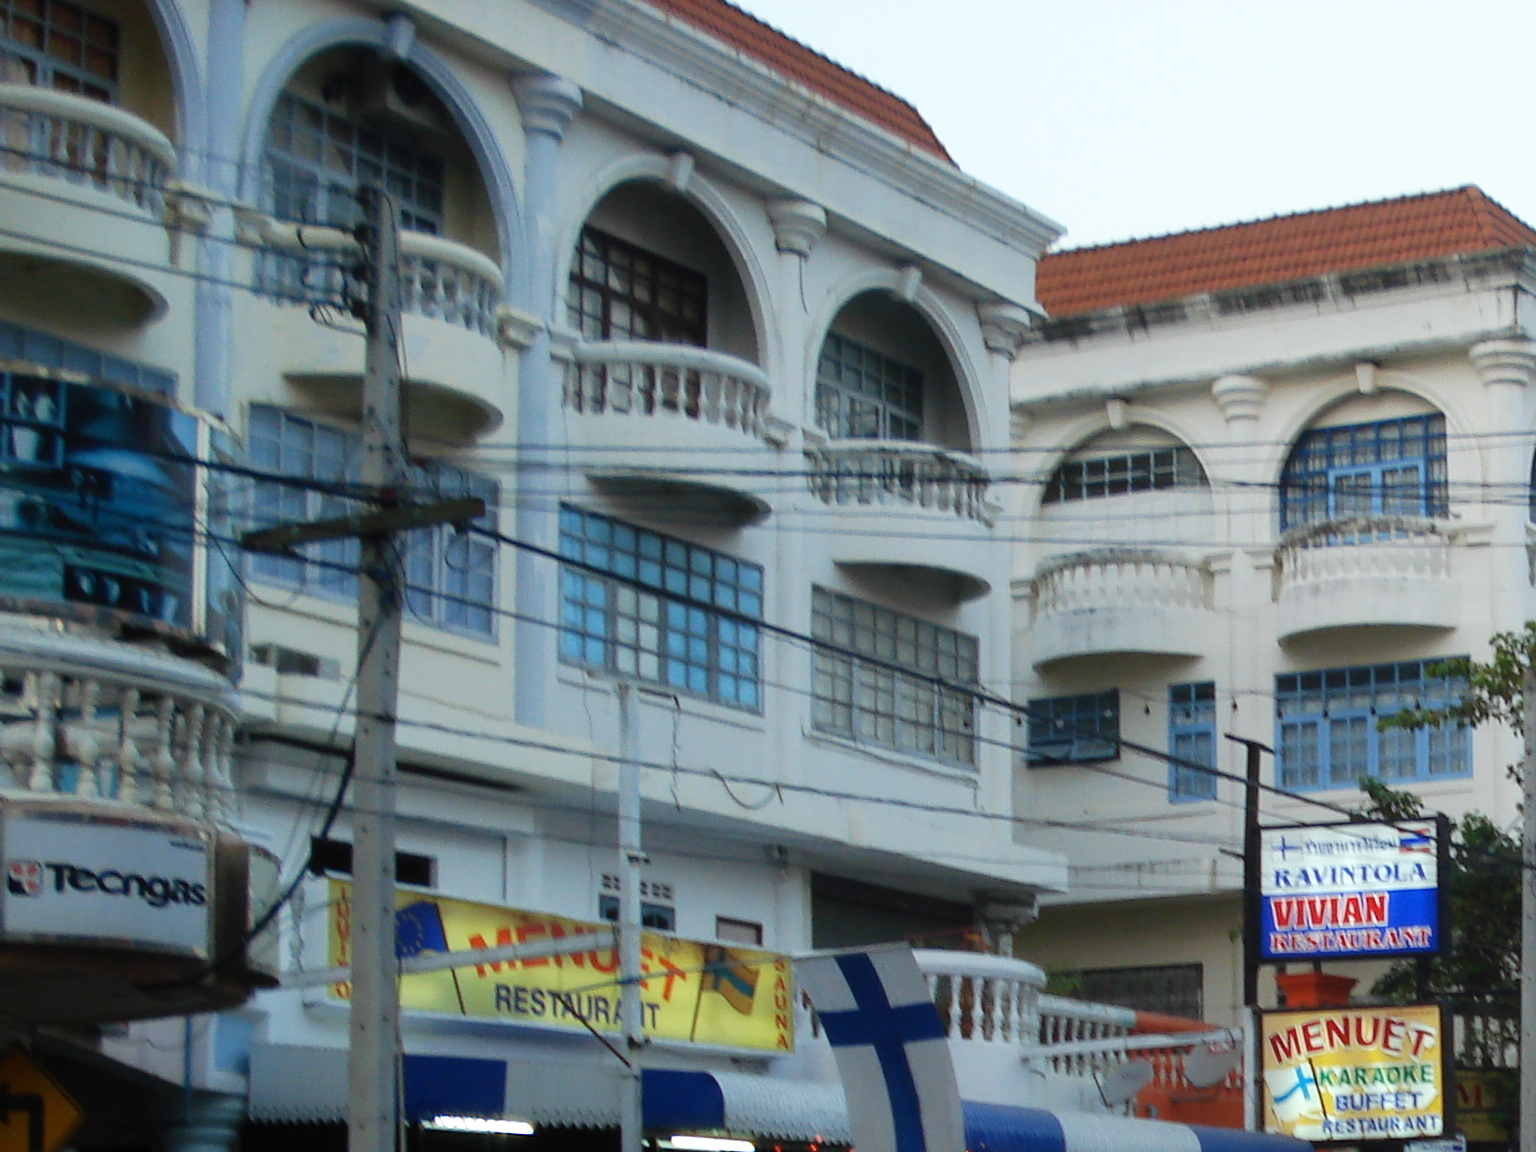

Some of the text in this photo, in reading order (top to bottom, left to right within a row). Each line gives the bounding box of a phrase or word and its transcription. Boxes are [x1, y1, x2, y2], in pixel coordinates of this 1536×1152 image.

[1271, 893, 1388, 930] VIVIAN
[1271, 927, 1432, 953] RESTAURANT
[774, 957, 789, 1050] SAUNA
[1268, 1016, 1434, 1064] MENUET
[1319, 1064, 1434, 1087] KARAOKE
[1335, 1091, 1423, 1112] BUFFET
[1322, 1115, 1439, 1134] RESTAURANT
